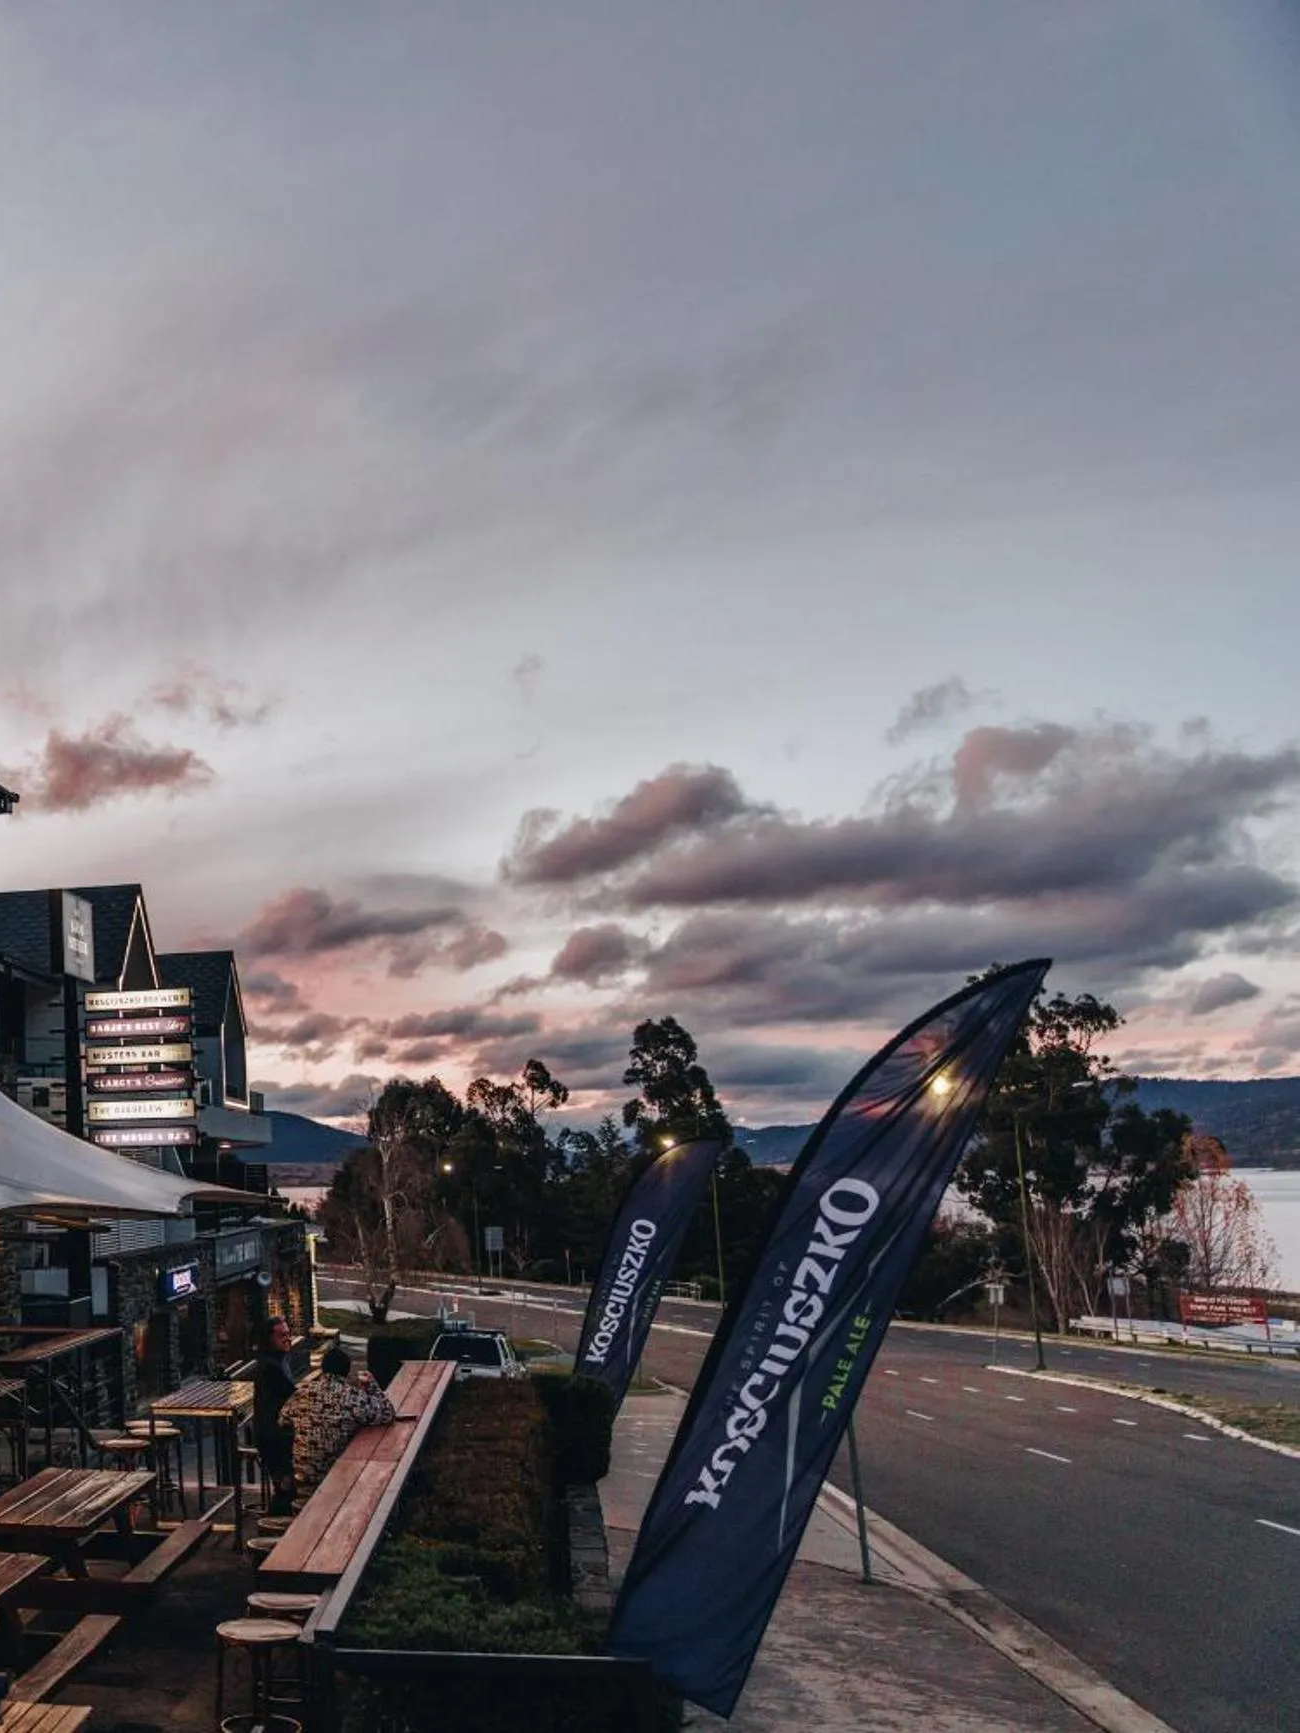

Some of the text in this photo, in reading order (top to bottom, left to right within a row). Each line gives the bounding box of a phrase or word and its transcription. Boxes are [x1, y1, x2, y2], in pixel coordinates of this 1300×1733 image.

[142, 1050, 161, 1058] BAR
[585, 1219, 656, 1363] KOSCIUSZKO
[821, 1315, 871, 1409] PALE ALE
